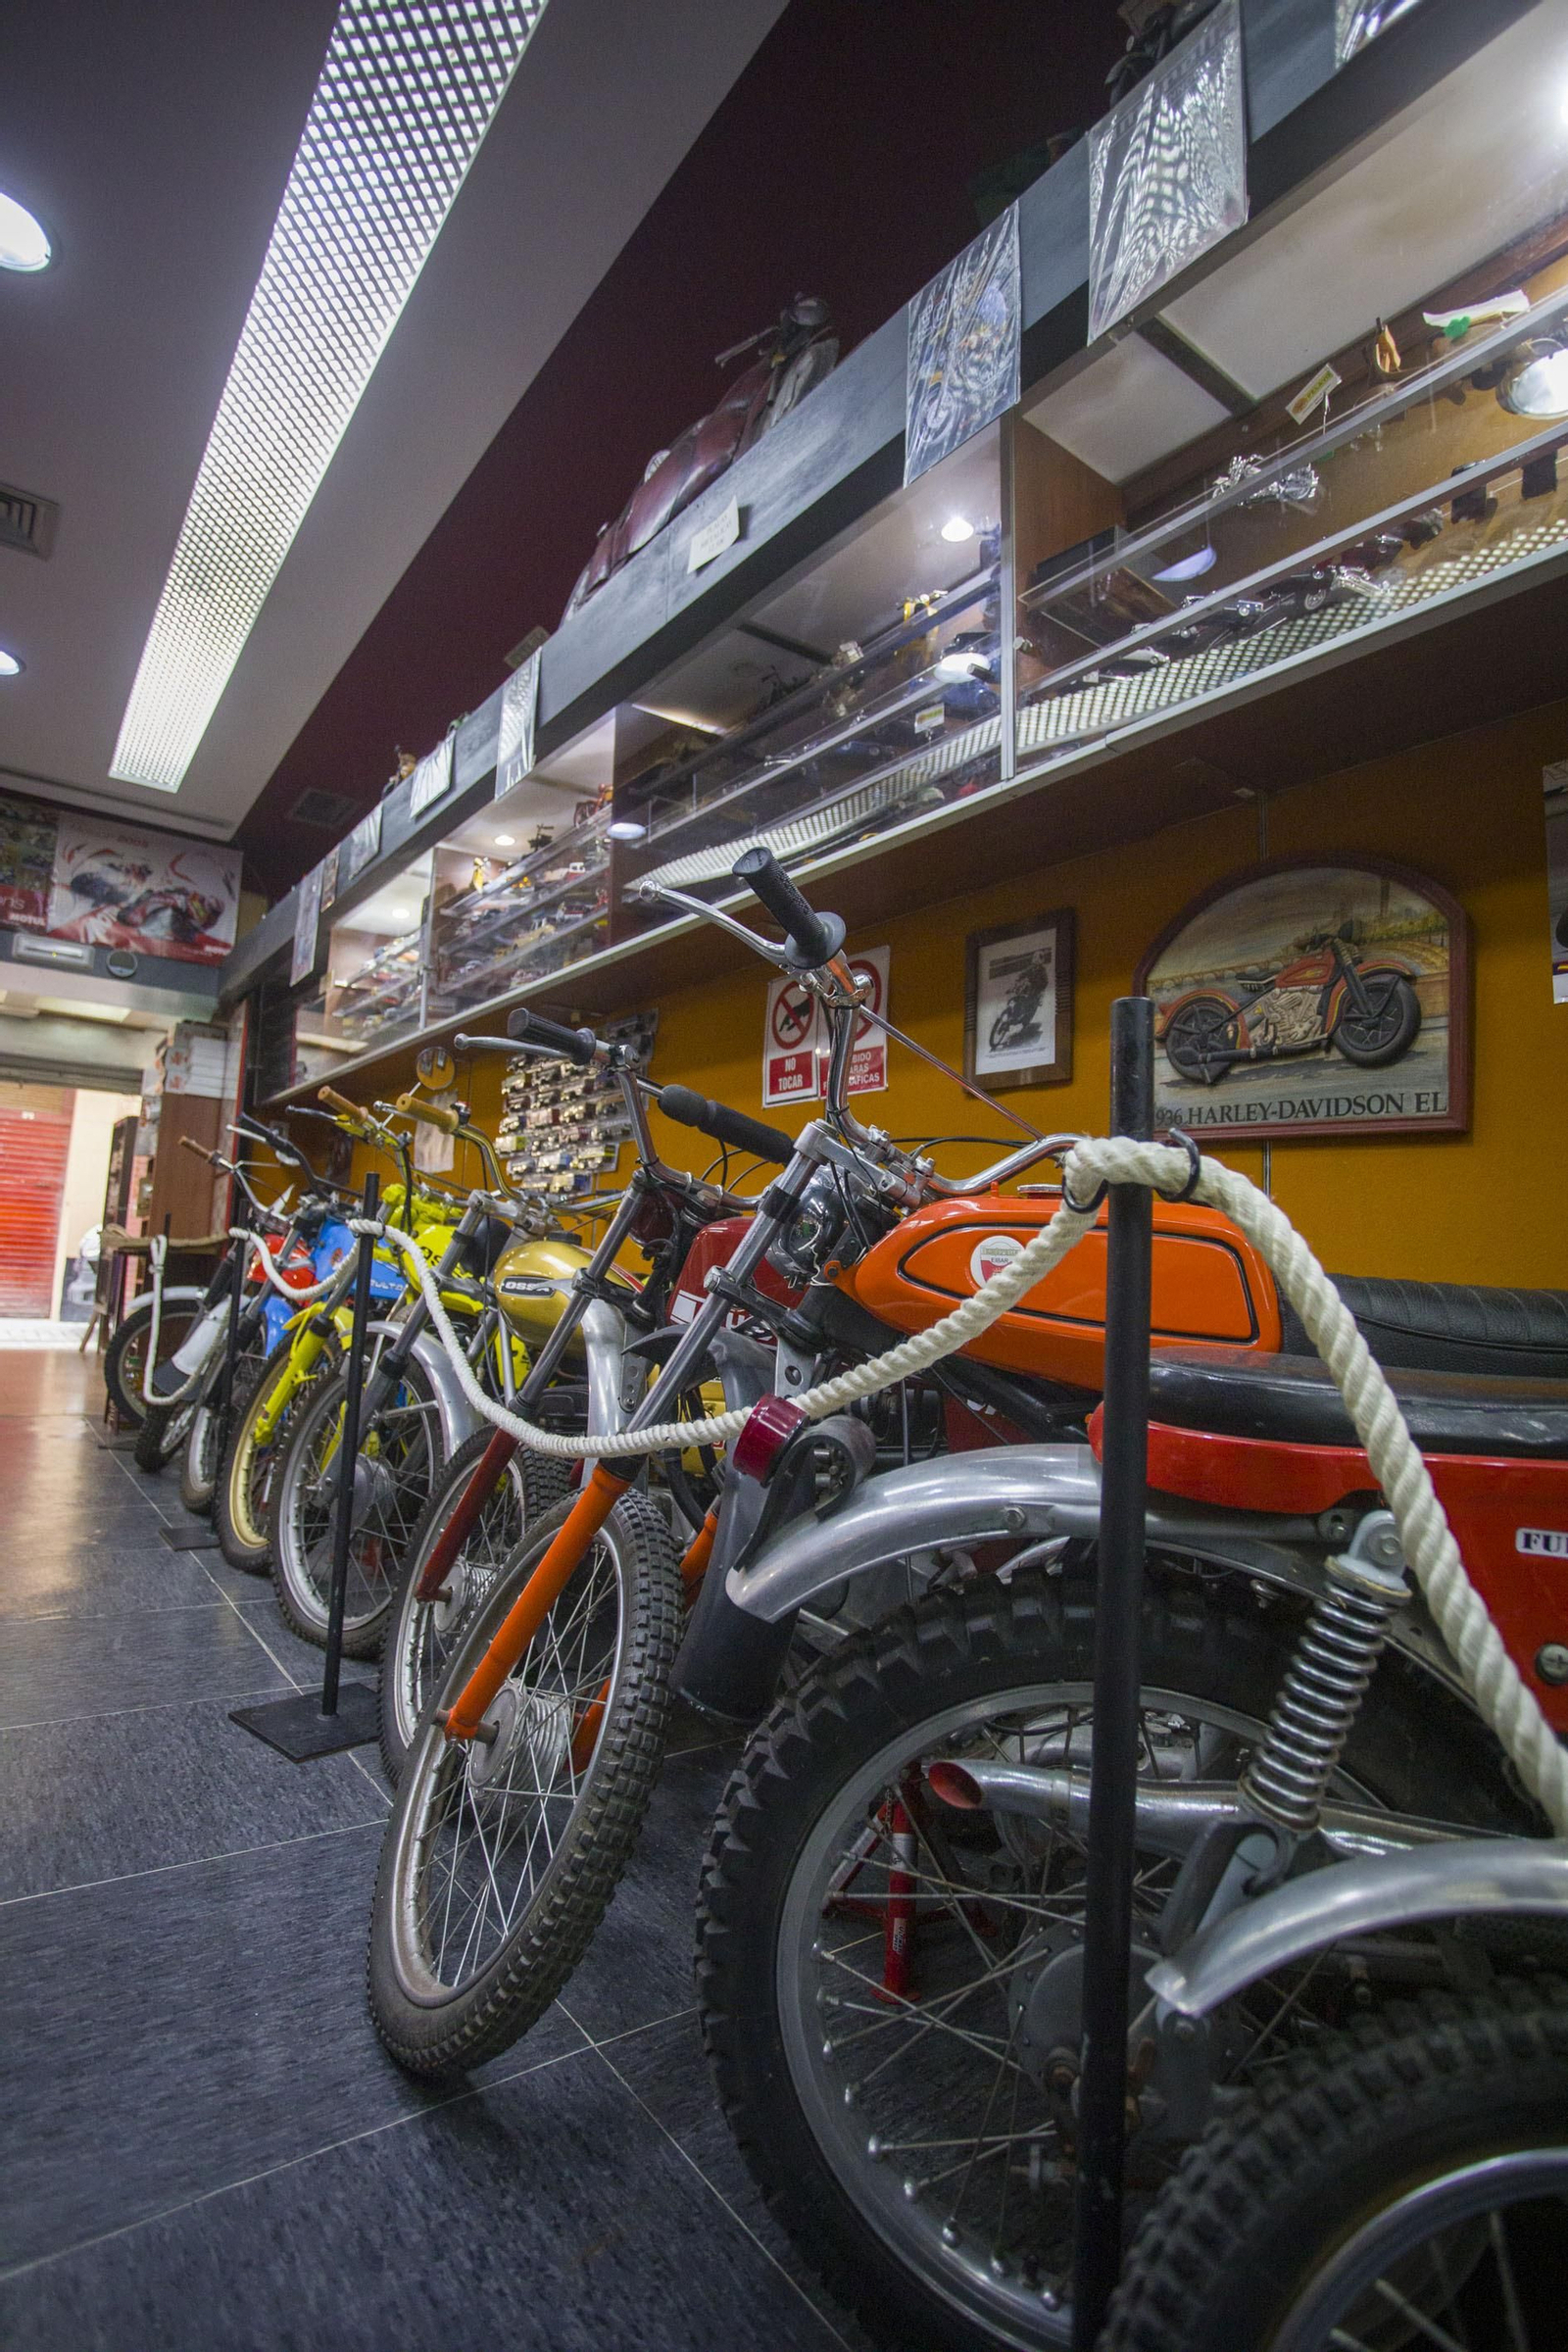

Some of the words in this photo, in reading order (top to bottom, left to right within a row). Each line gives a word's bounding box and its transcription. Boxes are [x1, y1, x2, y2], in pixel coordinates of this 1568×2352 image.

[785, 1057, 796, 1072] NO
[852, 1052, 871, 1063] BIDO
[778, 1074, 803, 1091] TOCAR
[1156, 1107, 1183, 1126] 936
[1187, 1092, 1405, 1125] HARLEY-DAVIDSON
[1415, 1092, 1447, 1114] EL
